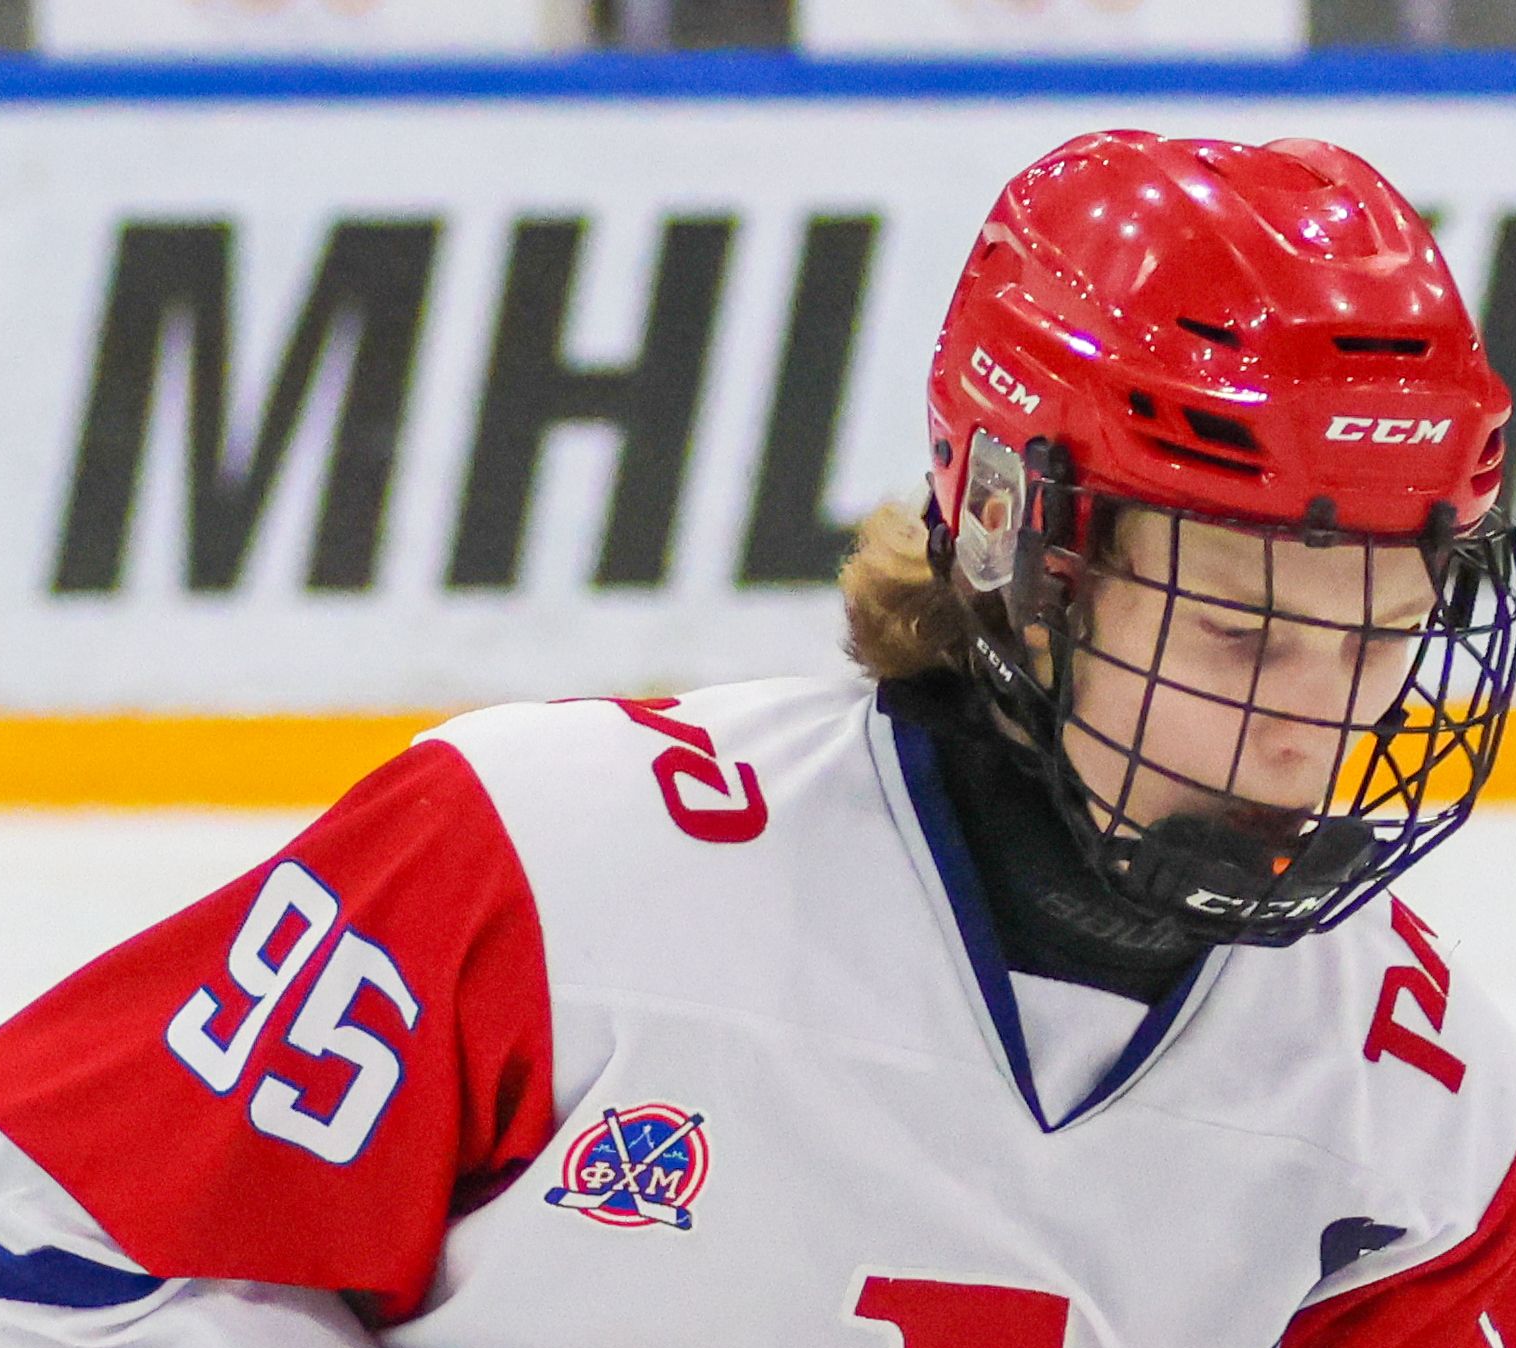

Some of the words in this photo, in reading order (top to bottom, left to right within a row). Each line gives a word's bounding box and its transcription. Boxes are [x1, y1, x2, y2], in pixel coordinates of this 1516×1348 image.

[970, 345, 1040, 414] CCM
[1325, 415, 1453, 446] CCM
[164, 858, 422, 1165] 95
[580, 1160, 685, 1200] ФХМ
